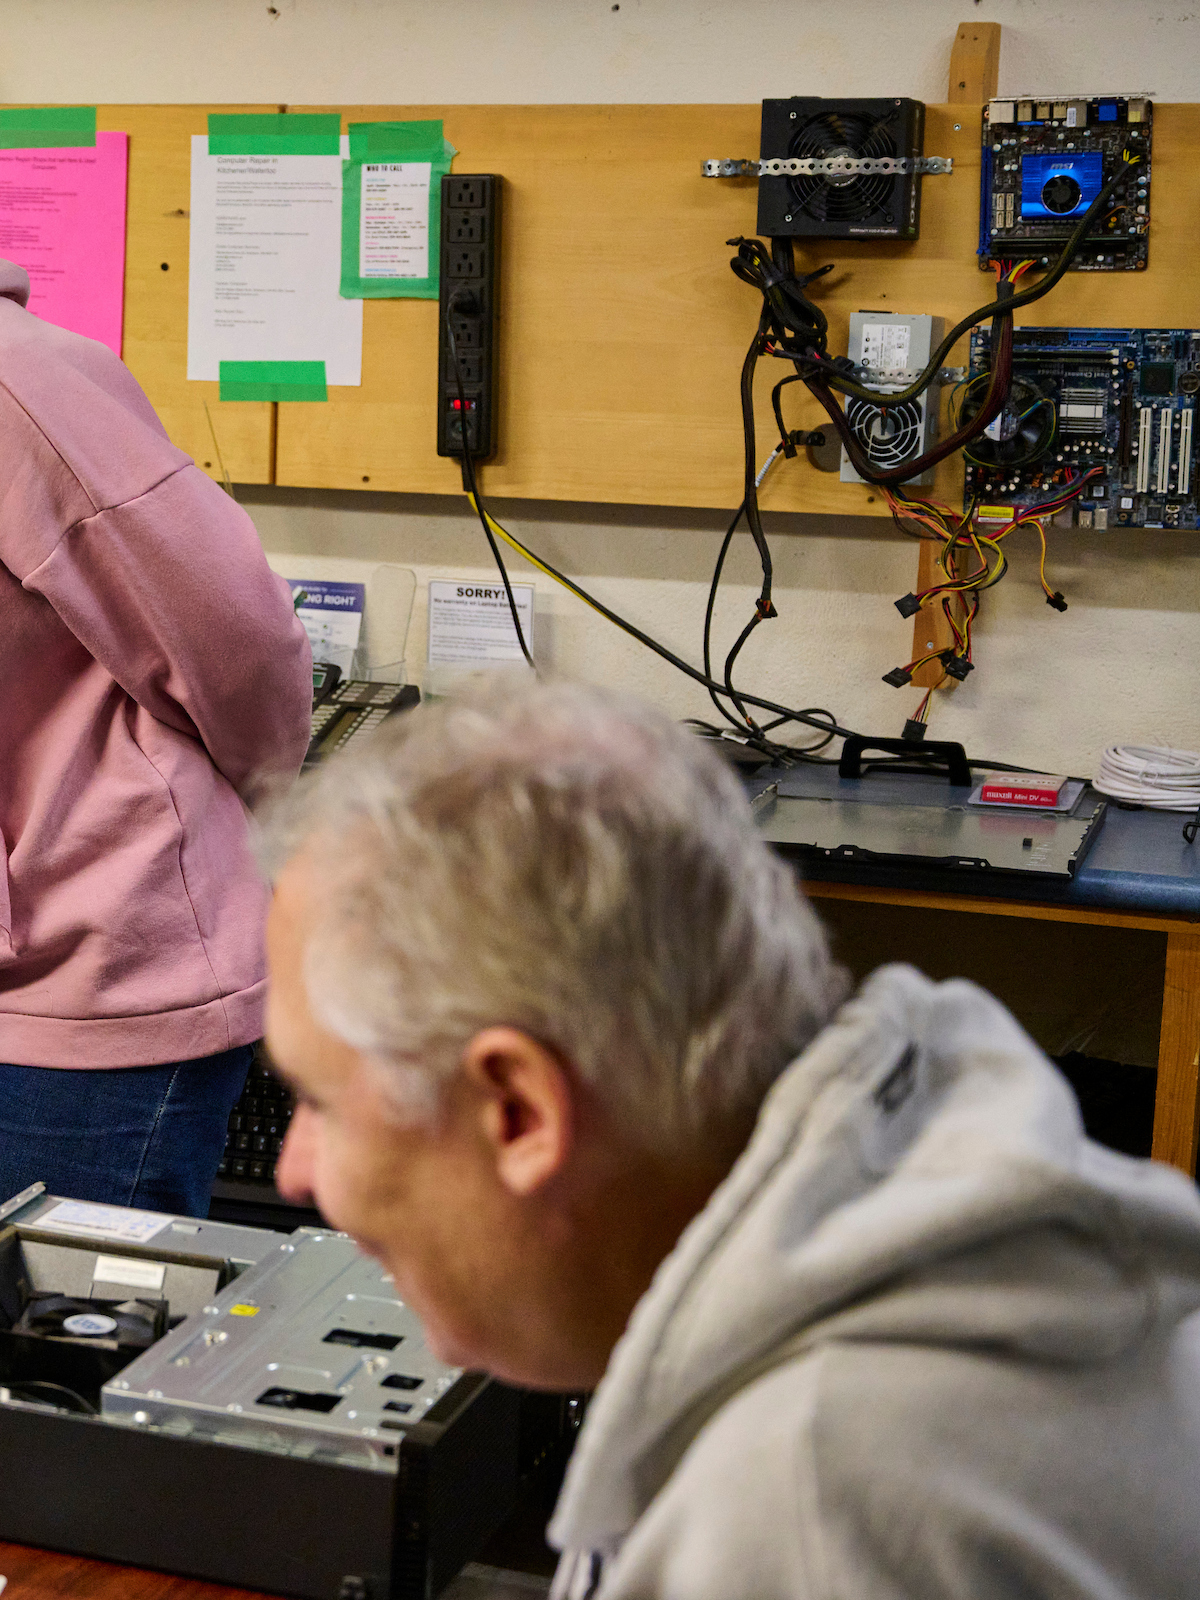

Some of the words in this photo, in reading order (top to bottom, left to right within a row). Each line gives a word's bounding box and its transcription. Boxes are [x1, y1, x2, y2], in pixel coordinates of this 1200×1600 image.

[217, 156, 247, 164] Computer
[249, 156, 270, 164] Repair
[456, 586, 505, 600] SORRY!
[304, 593, 323, 604] NG
[323, 594, 356, 606] RIGHT
[986, 791, 1013, 799] maxell
